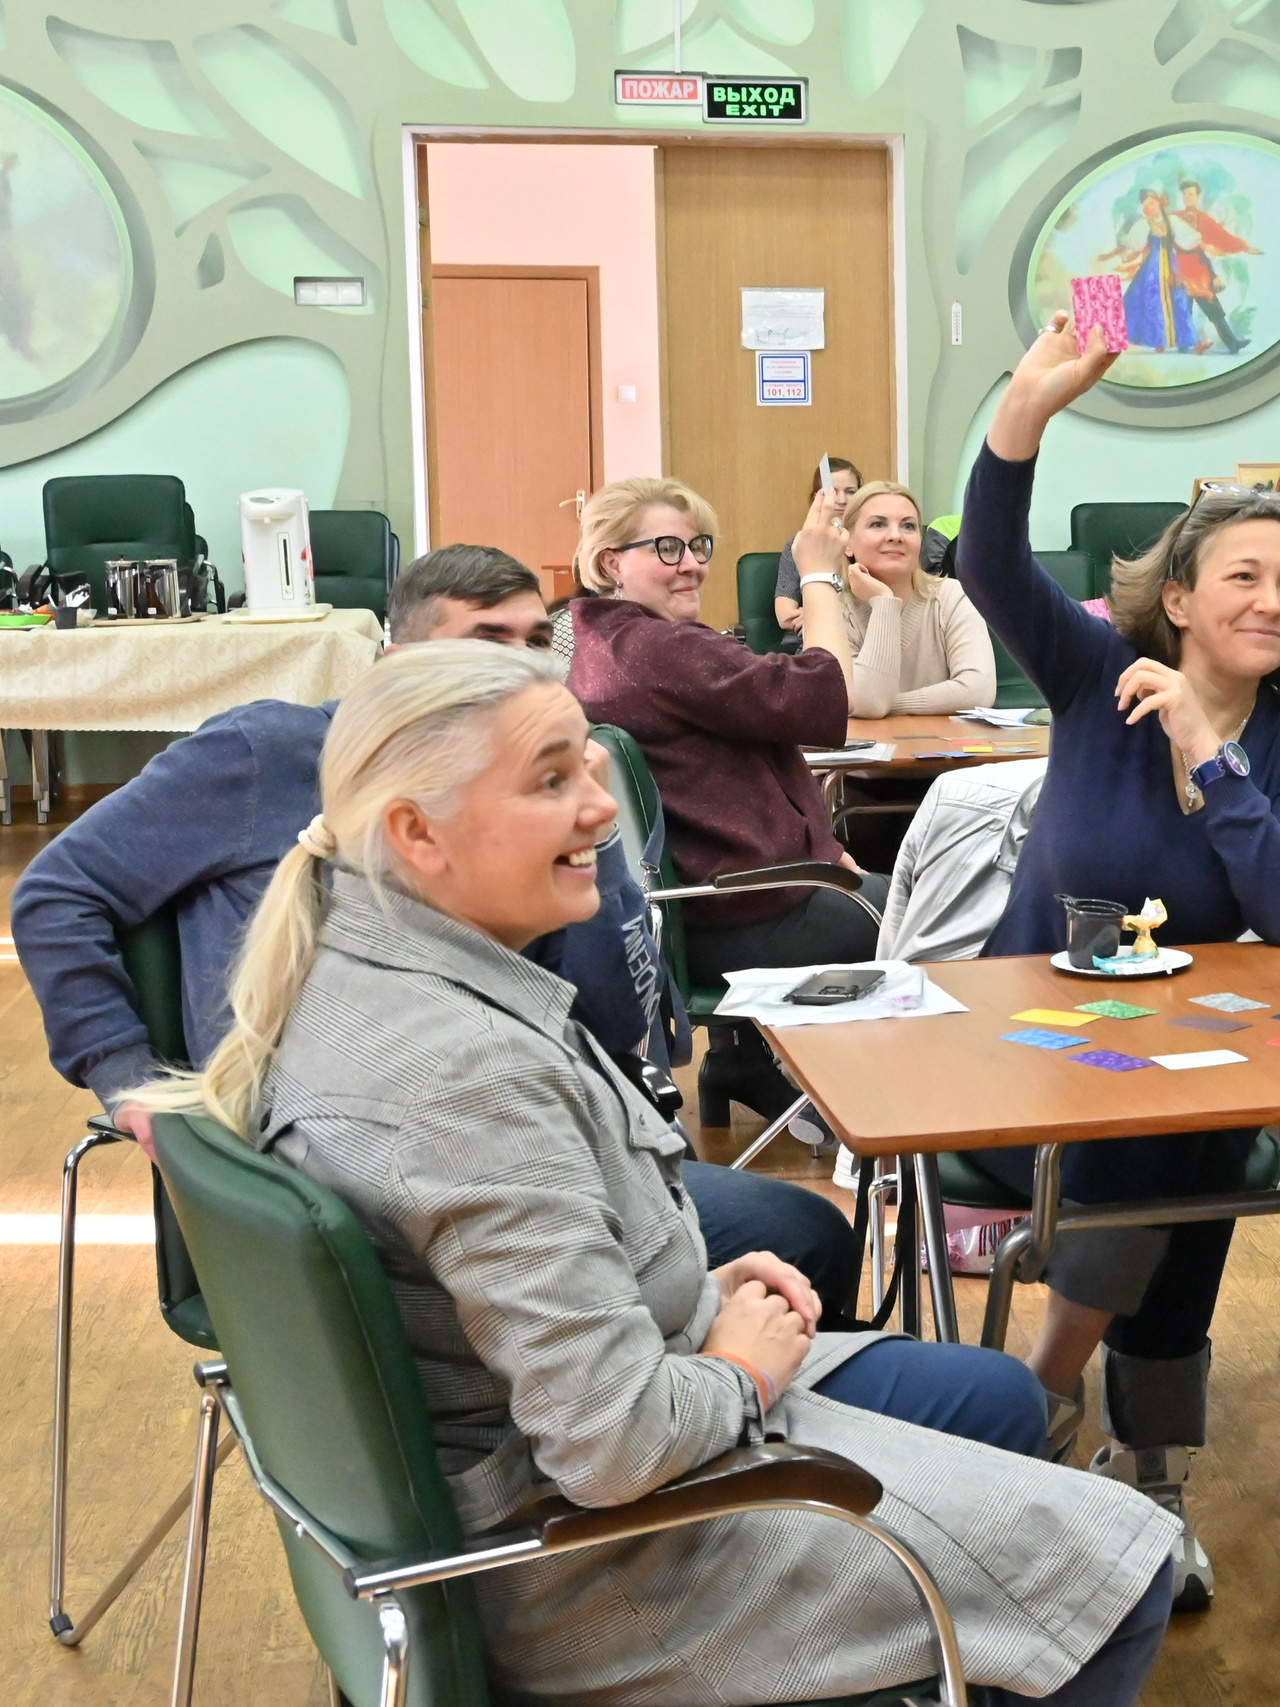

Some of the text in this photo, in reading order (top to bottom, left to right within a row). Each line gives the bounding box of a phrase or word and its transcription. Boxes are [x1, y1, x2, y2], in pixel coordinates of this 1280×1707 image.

[625, 79, 695, 99] ПОЖАР
[713, 86, 795, 105] ВЫХОД
[725, 104, 784, 116] EXIT
[767, 388, 802, 397] 101, 112
